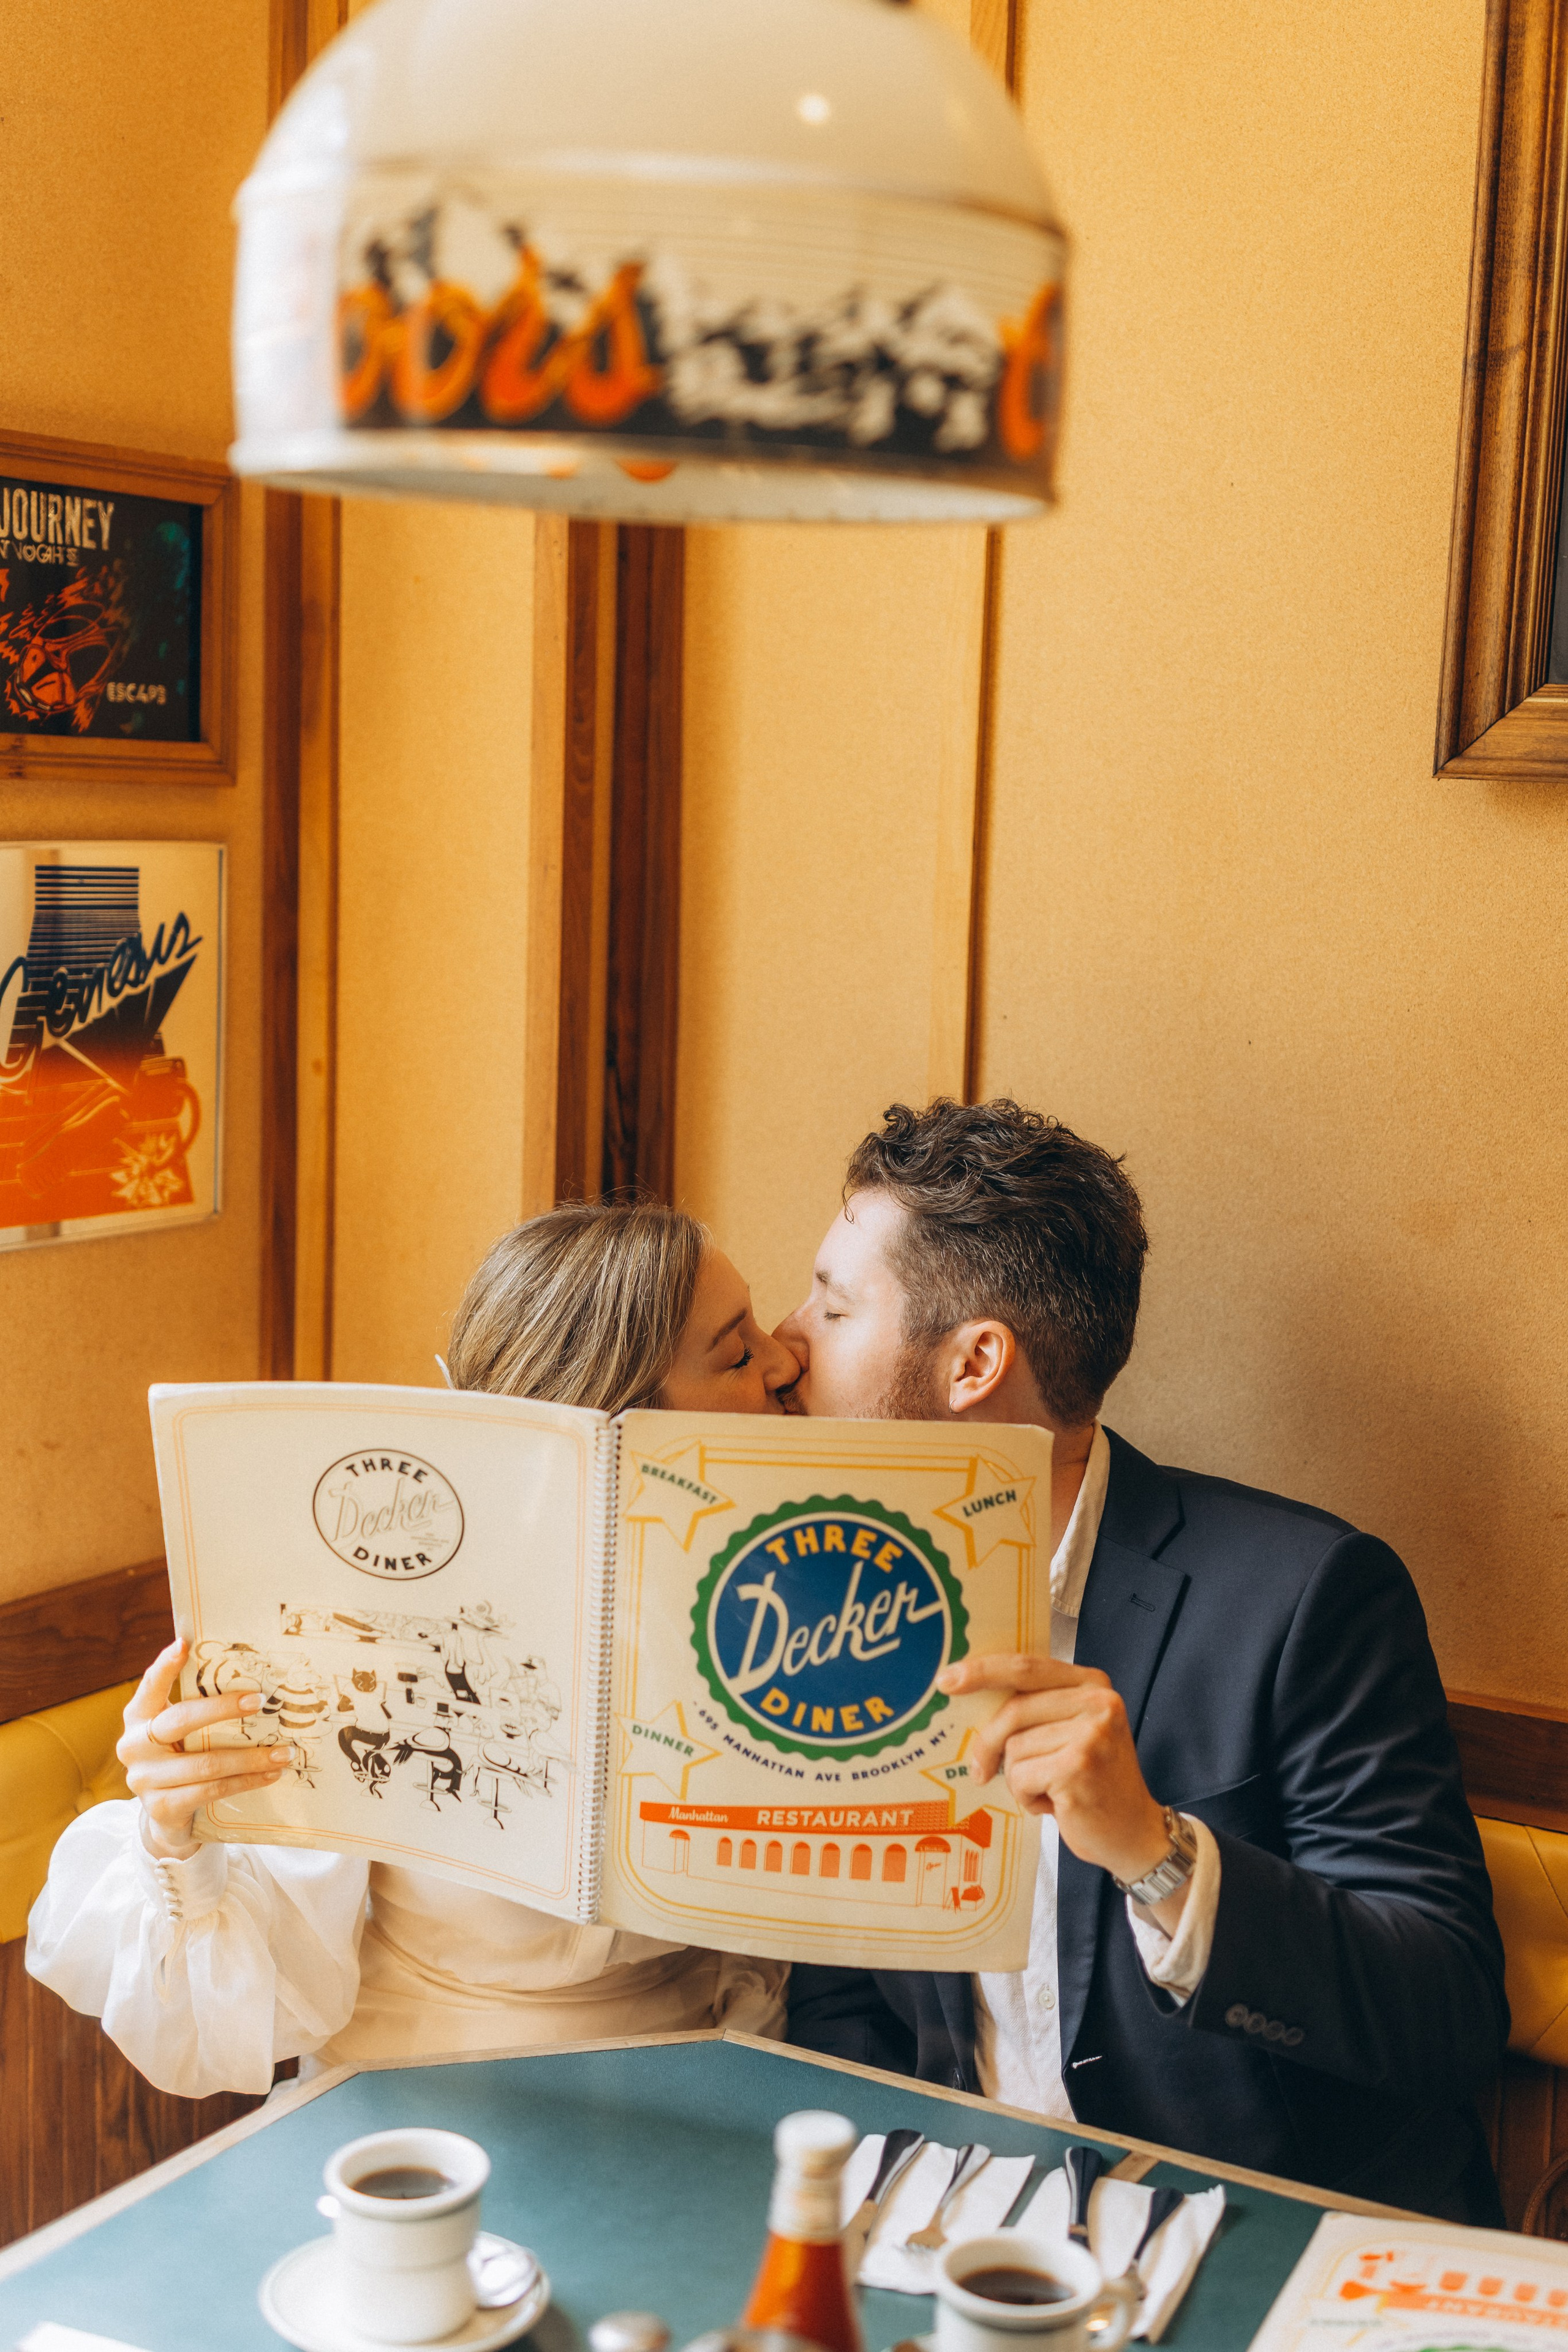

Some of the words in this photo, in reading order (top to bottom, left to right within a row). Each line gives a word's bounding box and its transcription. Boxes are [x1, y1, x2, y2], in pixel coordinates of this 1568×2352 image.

[0, 487, 115, 551] JOURNEY
[345, 1457, 428, 1483] THREE
[641, 1463, 718, 1504] BREAKFAST
[328, 1477, 456, 1551] Decker
[962, 1488, 1017, 1517] LUNCH
[352, 1546, 432, 1570] DINER
[764, 1524, 904, 1574] THREE
[729, 1559, 943, 1695] Decker
[760, 1686, 895, 1733] DINER
[632, 1724, 694, 1757] DINNER
[723, 1733, 805, 1779] MANHATTAN
[815, 1772, 841, 1782] AVE
[851, 1747, 925, 1781] BROOKLYN
[929, 1728, 947, 1747] NY
[667, 1806, 729, 1823] Manhattan
[756, 1809, 914, 1827] RESTAURANT
